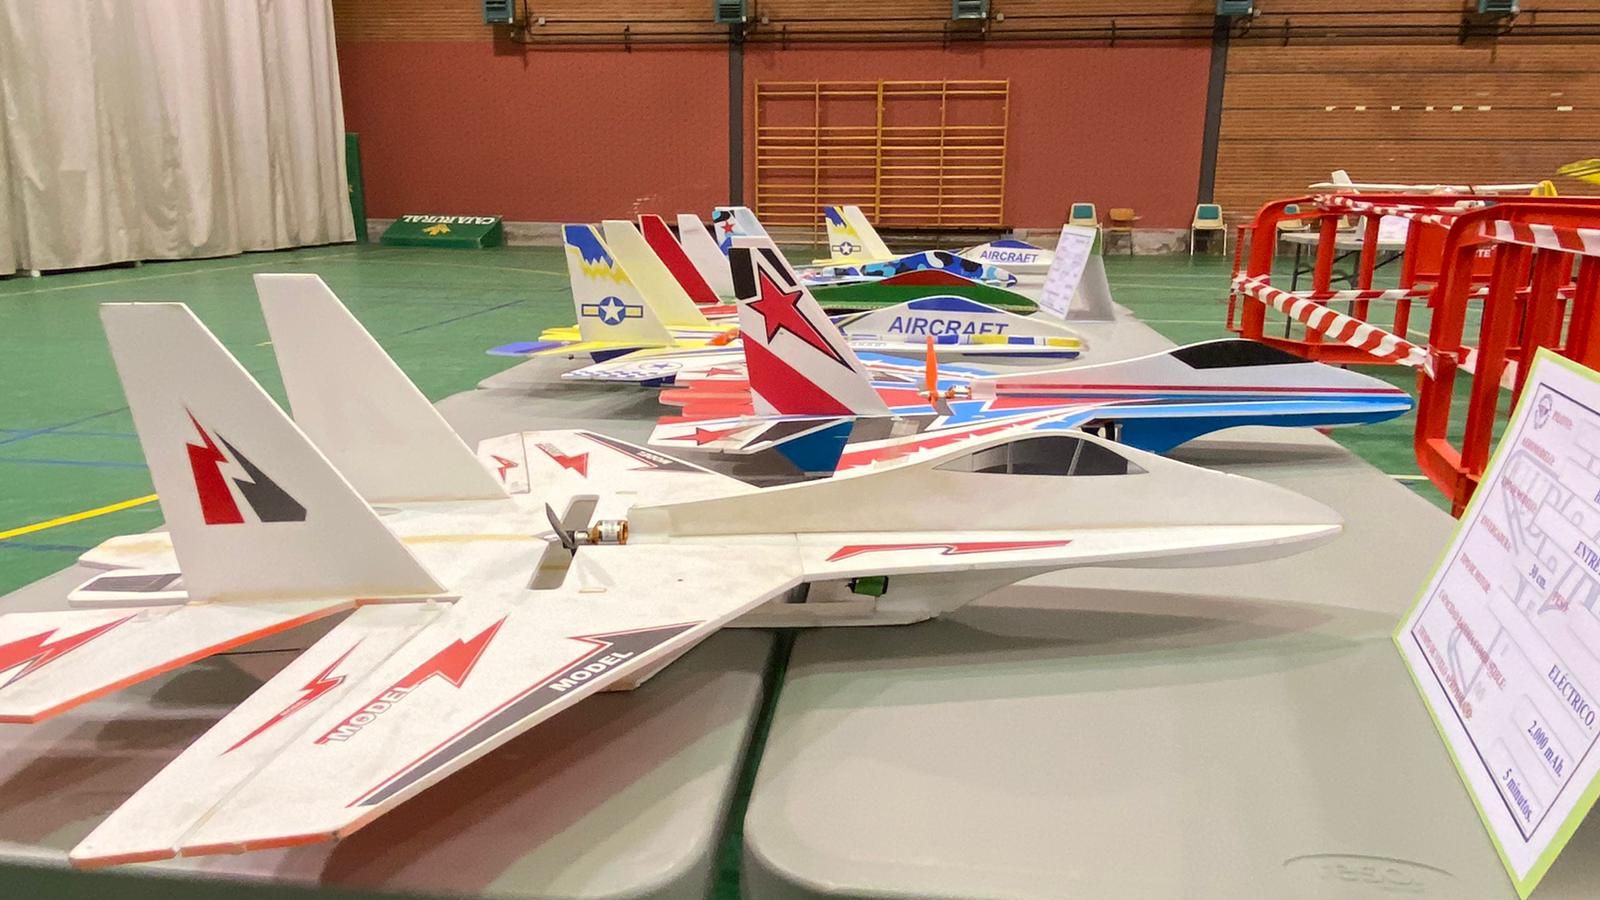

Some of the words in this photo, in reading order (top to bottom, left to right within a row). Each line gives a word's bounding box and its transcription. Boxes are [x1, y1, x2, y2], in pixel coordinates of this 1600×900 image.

[402, 215, 457, 224] RURAL
[457, 216, 496, 225] CAJA
[980, 250, 1039, 263] AIRCRAFT
[888, 316, 1009, 336] AIRCRAFT
[1574, 541, 1600, 574] ENTRE
[548, 651, 634, 692] MODEL
[326, 686, 415, 742] MODEL
[1502, 768, 1513, 781] 5
